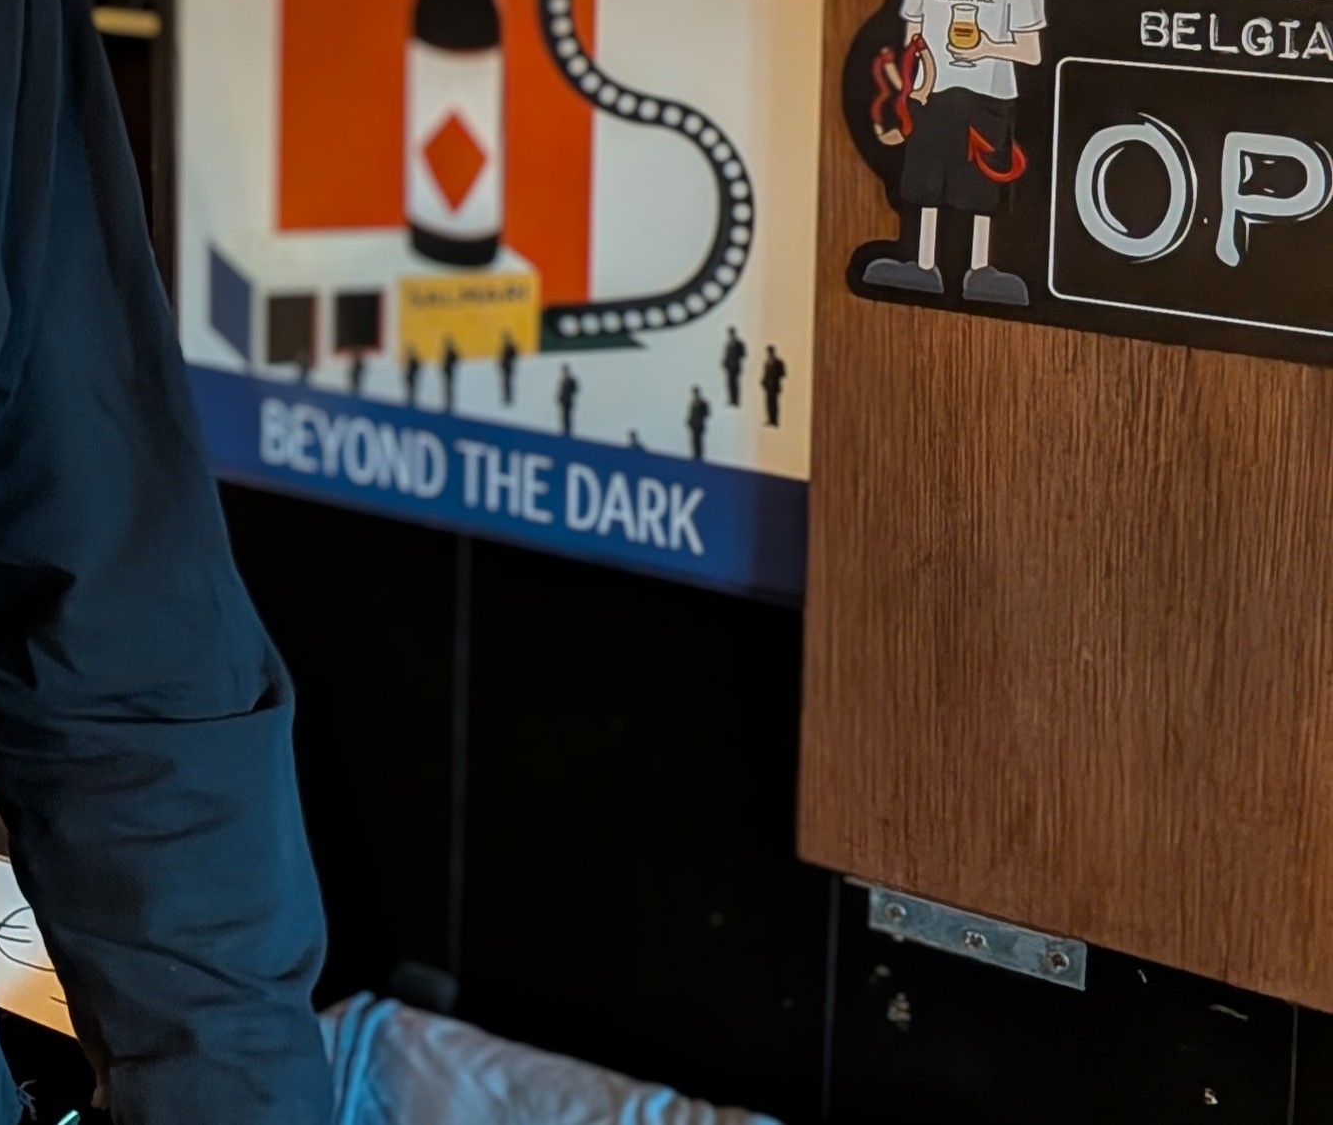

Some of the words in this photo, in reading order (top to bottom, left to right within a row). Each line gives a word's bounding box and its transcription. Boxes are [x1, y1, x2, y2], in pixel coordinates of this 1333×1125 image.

[1140, 10, 1333, 62] BELGIA
[1074, 112, 1333, 268] OP
[258, 397, 448, 499] BEYOND
[454, 437, 556, 524] THE
[564, 451, 707, 557] DARK
